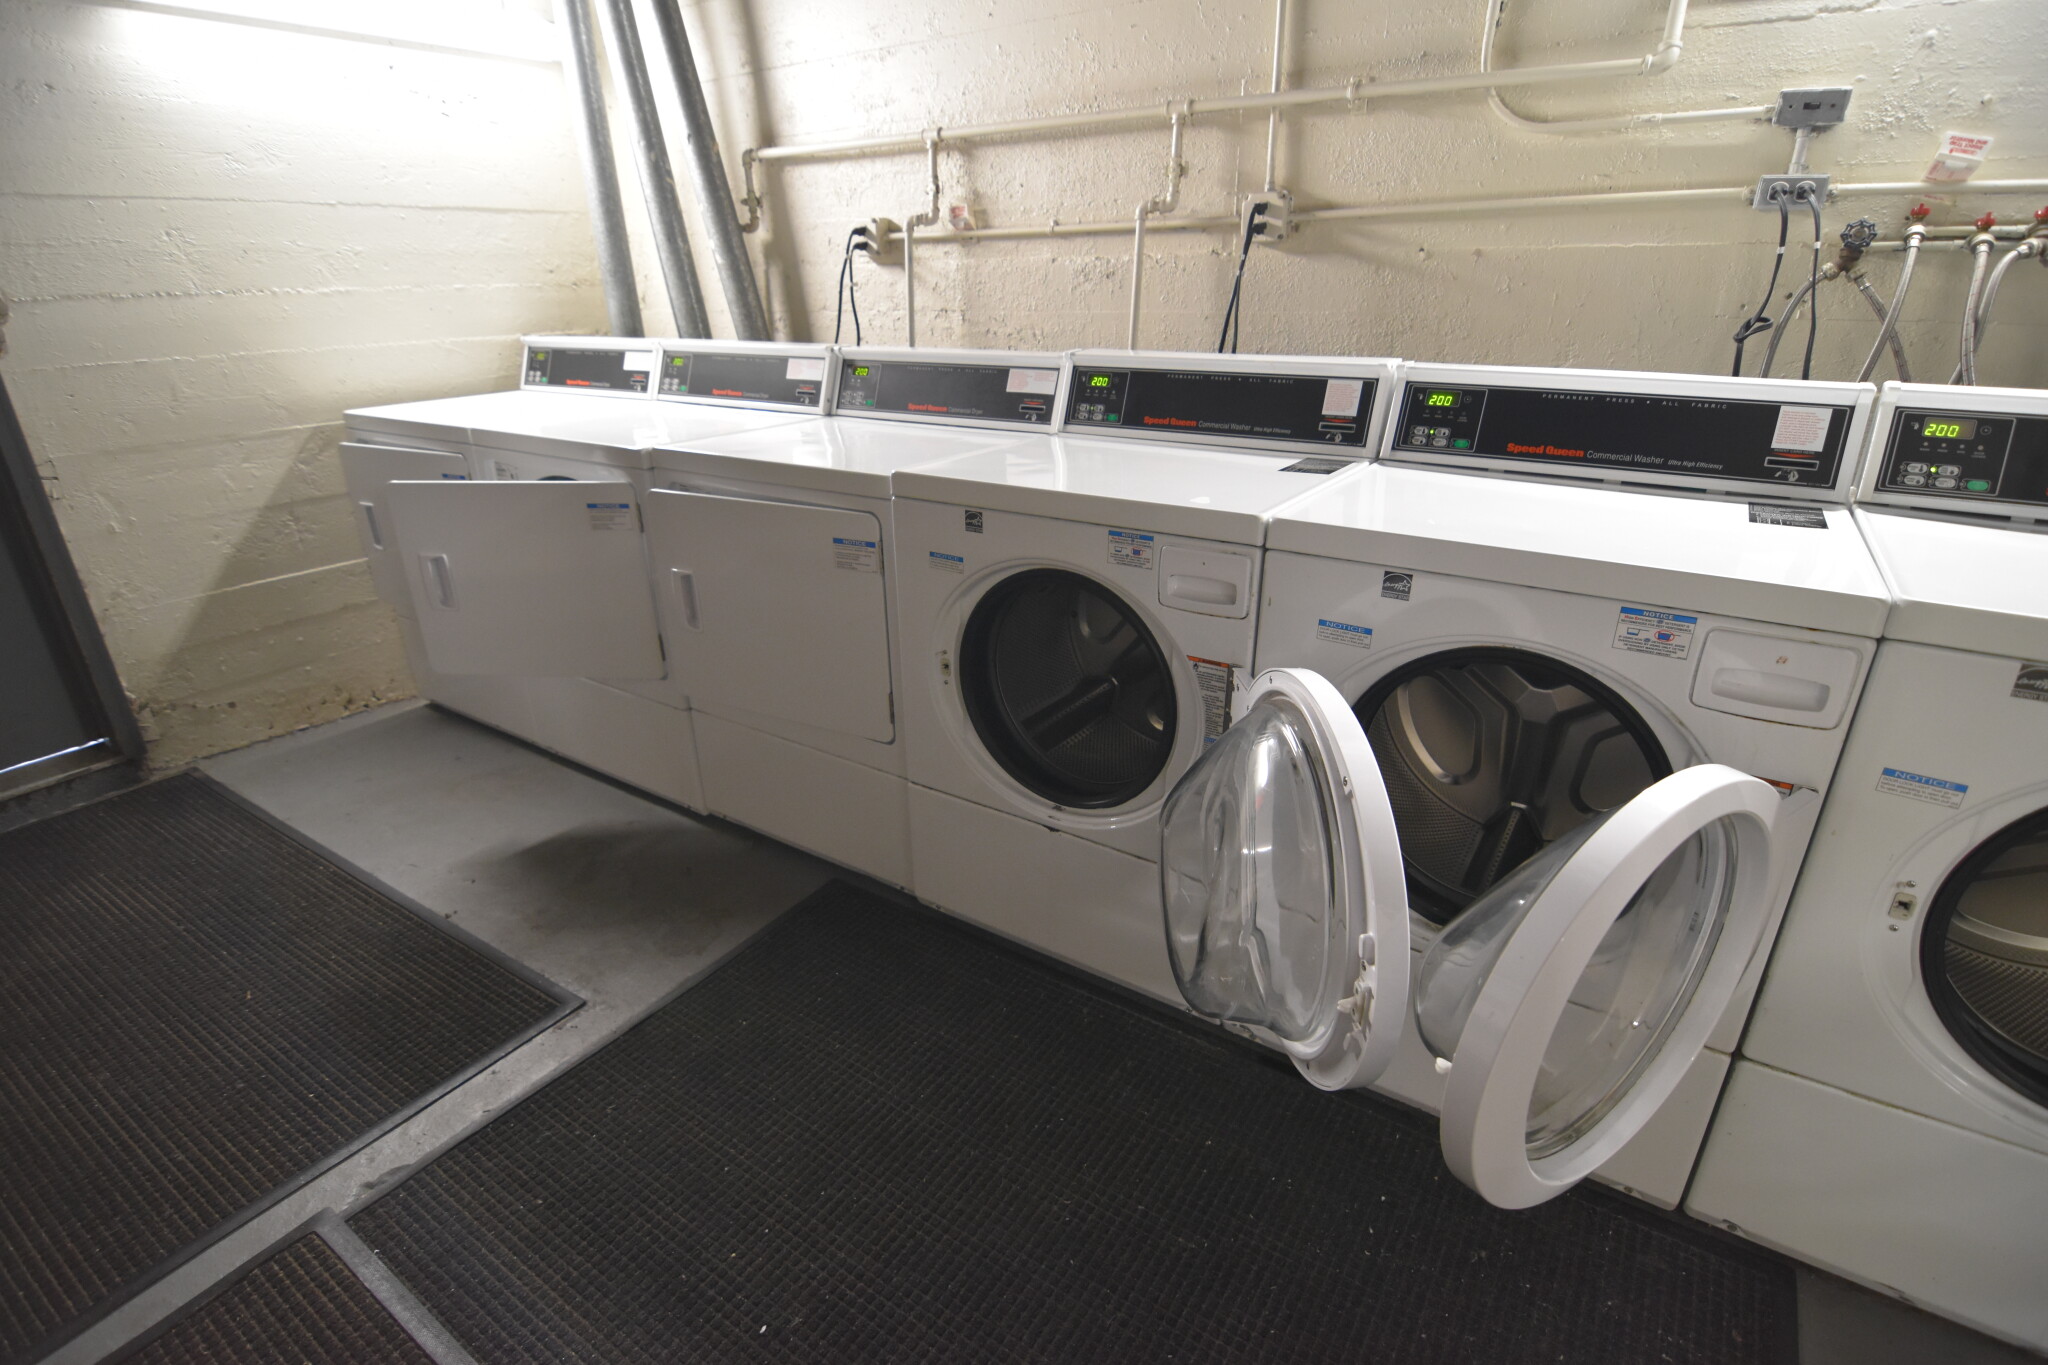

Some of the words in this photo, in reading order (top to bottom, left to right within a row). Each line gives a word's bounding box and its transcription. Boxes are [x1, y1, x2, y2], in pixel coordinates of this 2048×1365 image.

[855, 367, 868, 376] 200
[1092, 376, 1108, 386] 200
[1429, 395, 1452, 406] 200
[908, 402, 927, 411] Speed
[928, 404, 948, 412] Queen
[1144, 416, 1170, 426] Speed
[1170, 418, 1197, 428] Queen
[1198, 420, 1230, 430] Commercial
[1231, 423, 1251, 432] Washer
[1924, 424, 1960, 437] 200
[1507, 442, 1544, 454] Speed
[1546, 444, 1584, 458] Queen
[1586, 450, 1632, 462] Commercial
[1634, 454, 1664, 465] Washer
[1682, 460, 1696, 468] High
[1696, 462, 1724, 470] Efficiency
[1643, 611, 1674, 620] NOTICE
[1326, 621, 1365, 633] NOTICE
[1894, 771, 1955, 789] NOTICE
